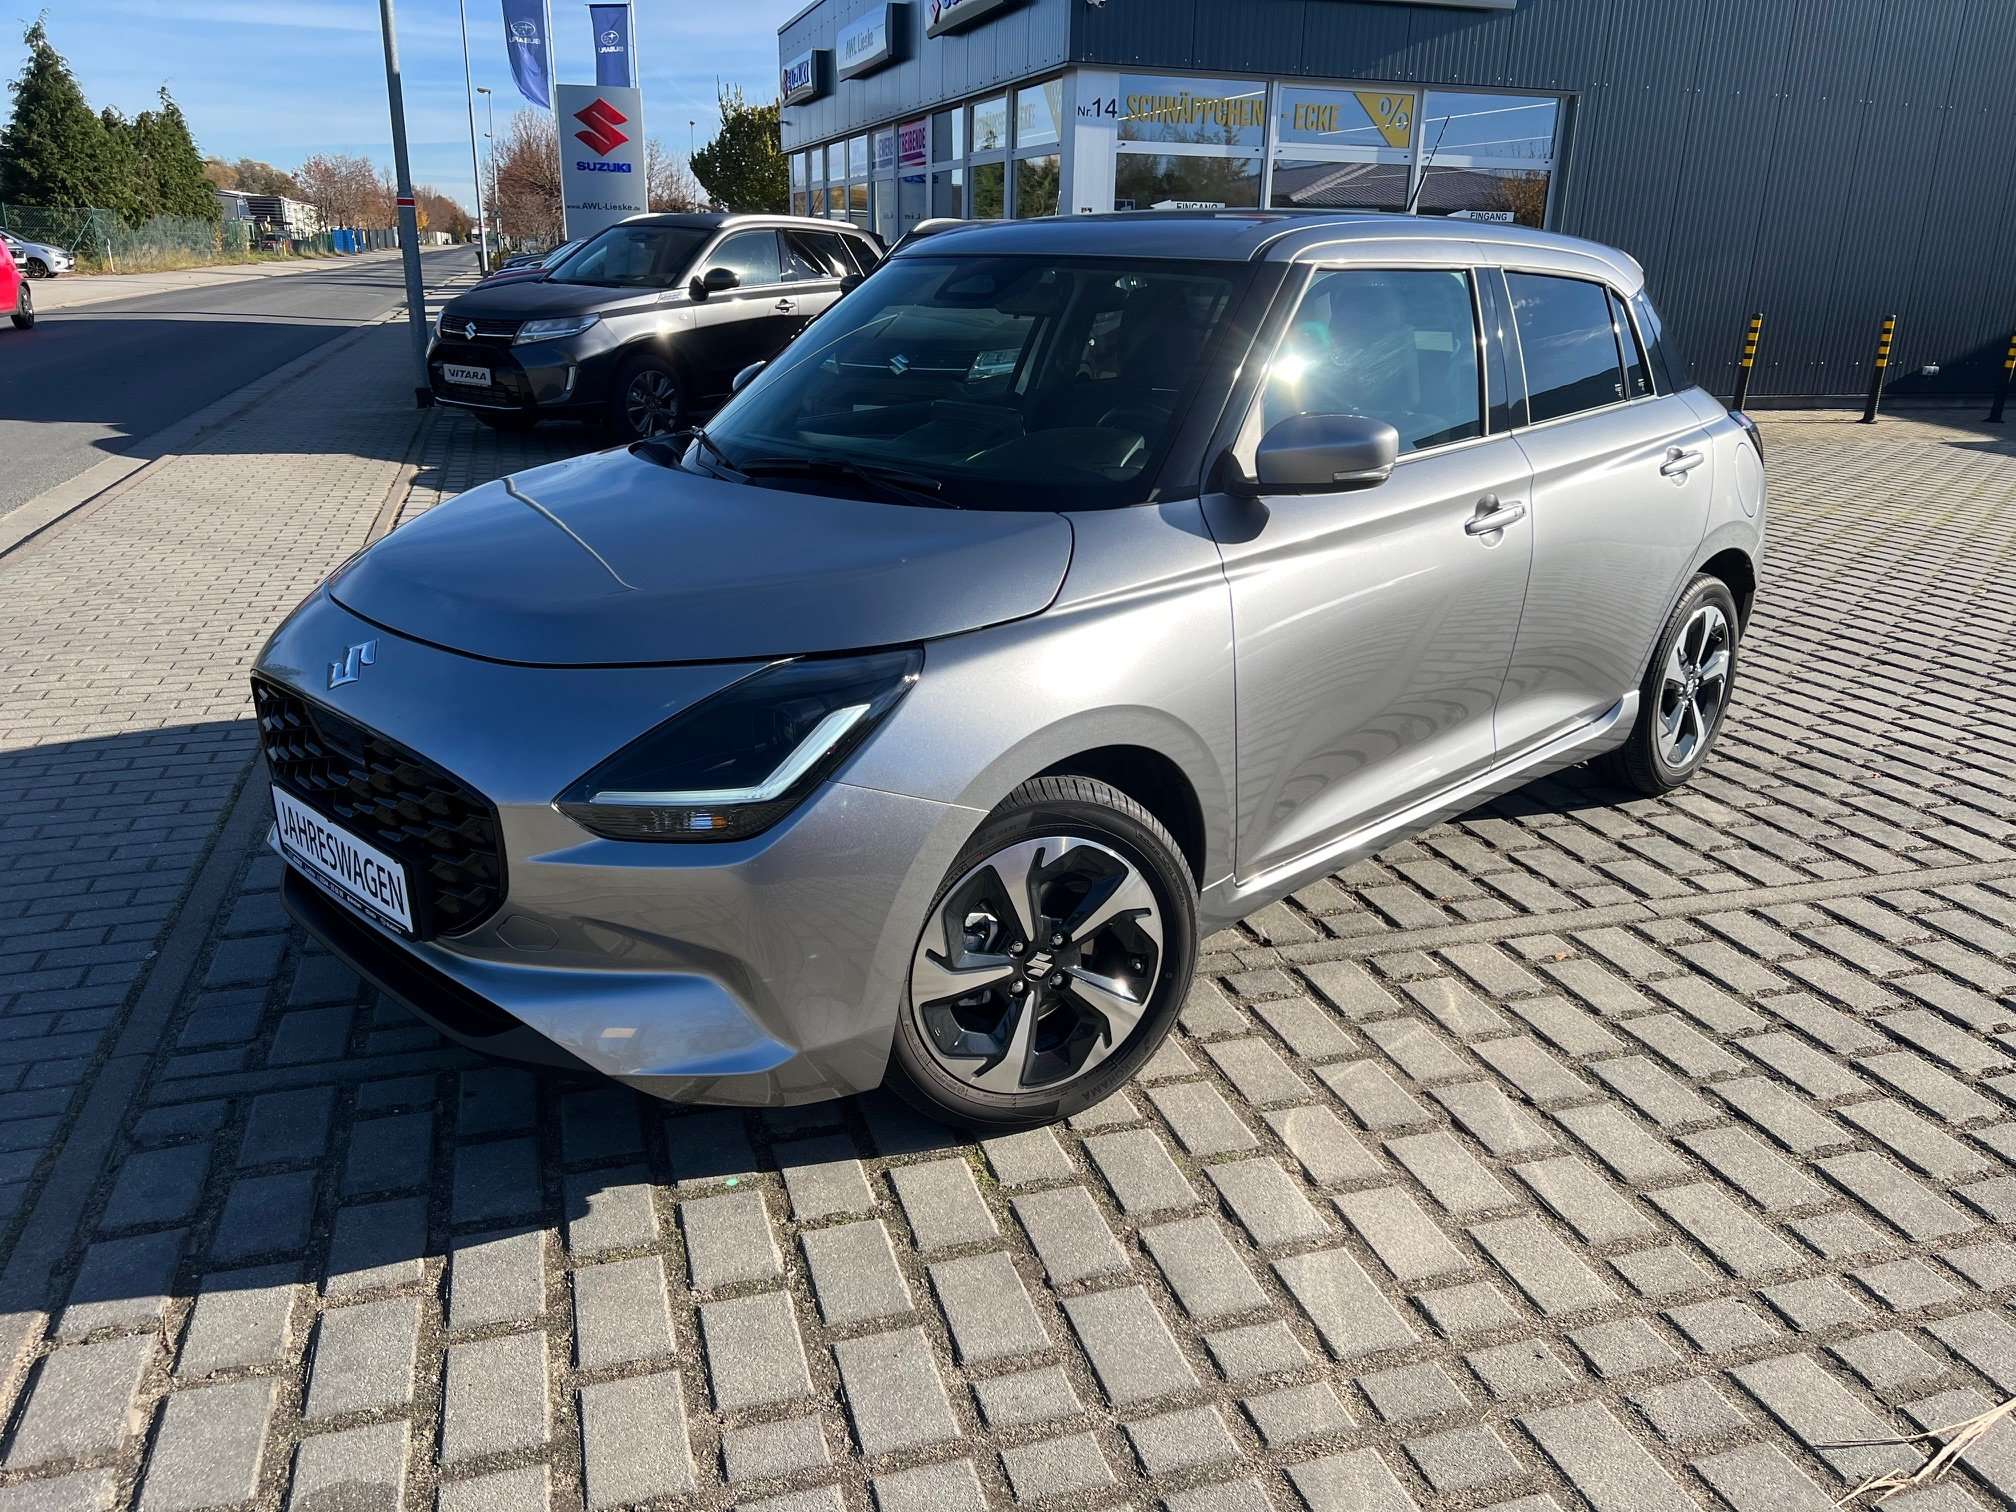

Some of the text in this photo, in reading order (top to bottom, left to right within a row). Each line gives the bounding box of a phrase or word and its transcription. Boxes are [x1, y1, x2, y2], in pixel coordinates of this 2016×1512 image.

[1077, 97, 1118, 119] Nr. 14
[1126, 92, 1265, 127] SCHNÄPPCHEN
[1294, 103, 1342, 132] ECKE
[576, 161, 632, 173] SUZUKI
[1470, 212, 1508, 221] EINGANG
[448, 368, 487, 381] VITARA
[281, 801, 405, 916] JAHRESWAGEN
